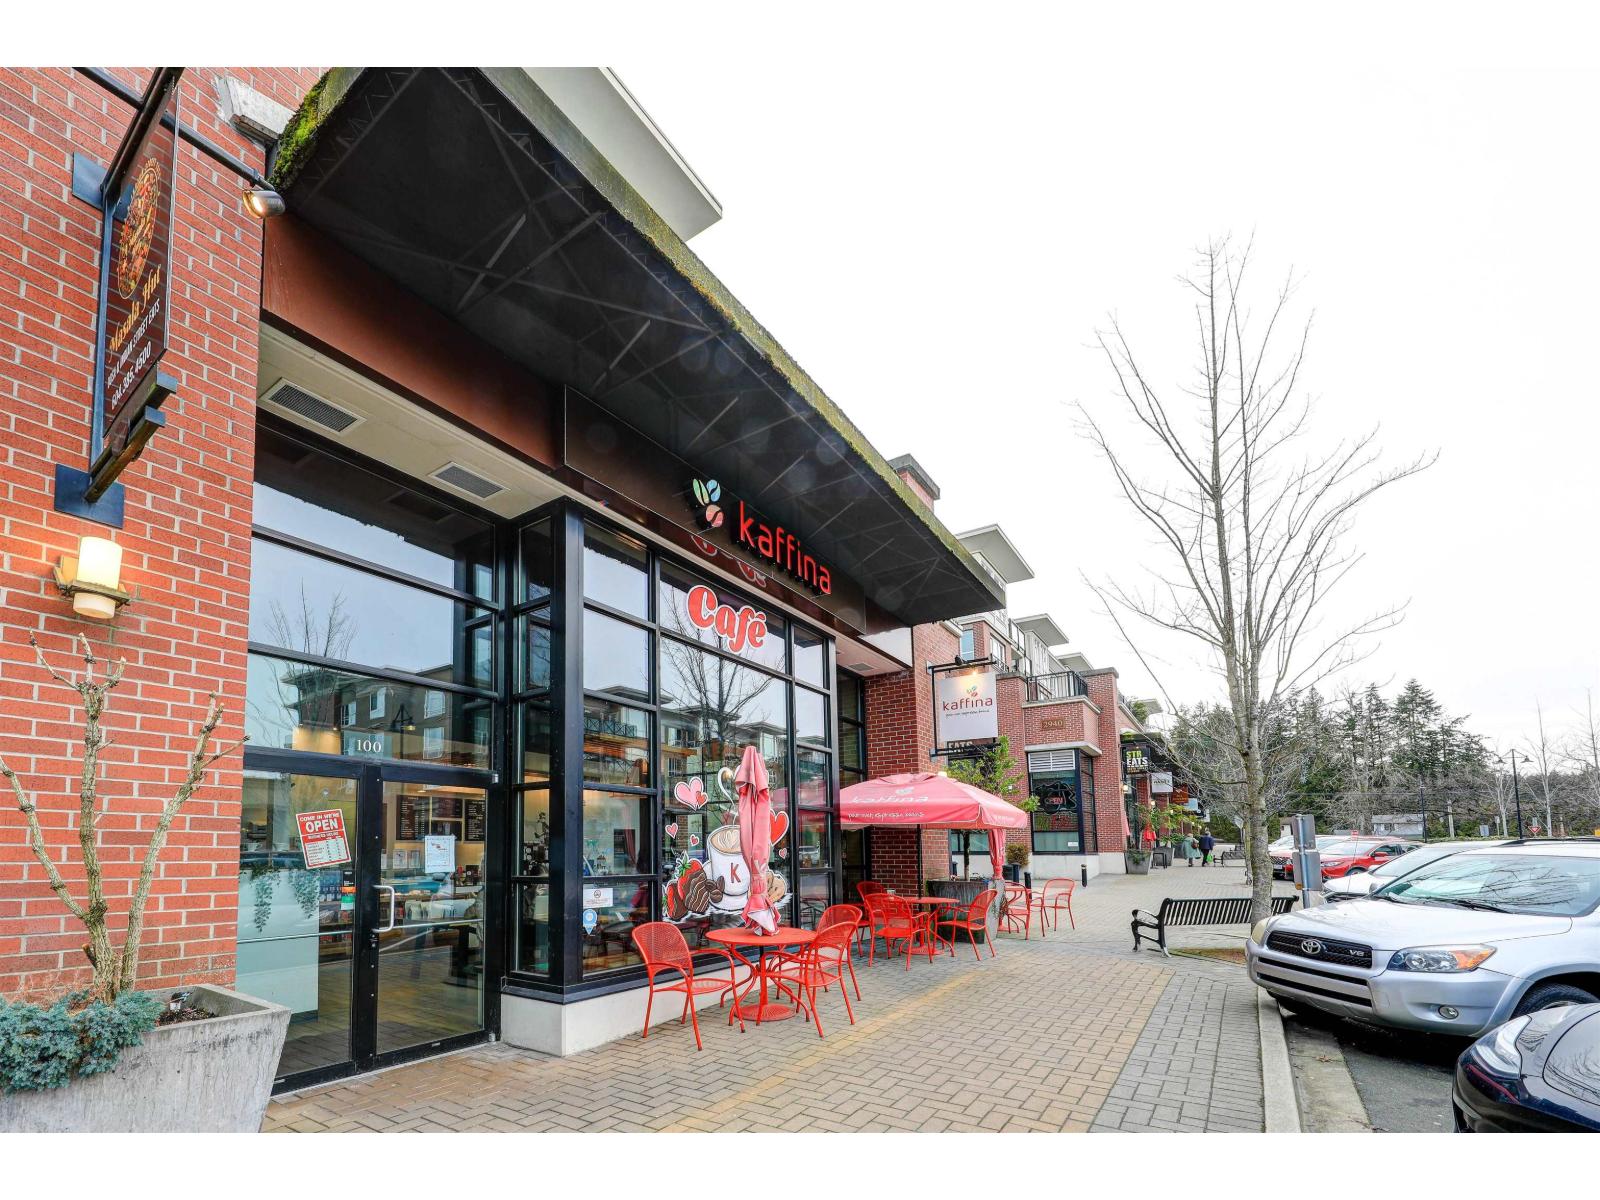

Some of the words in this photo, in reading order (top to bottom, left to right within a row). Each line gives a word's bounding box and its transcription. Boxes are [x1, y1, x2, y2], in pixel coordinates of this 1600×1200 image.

[109, 300, 140, 363] Masala
[141, 264, 161, 312] Hut
[133, 314, 149, 347] STREET
[148, 297, 160, 325] EATS
[739, 500, 832, 595] kaffina
[687, 585, 767, 653] Café
[942, 697, 993, 711] kaffina
[1043, 720, 1063, 728] 2940
[357, 739, 382, 753] 100
[1126, 750, 1142, 758] STR
[1126, 757, 1148, 766] EATS
[305, 818, 339, 832] OPEN
[730, 862, 742, 883] K
[1349, 949, 1365, 957] V6
